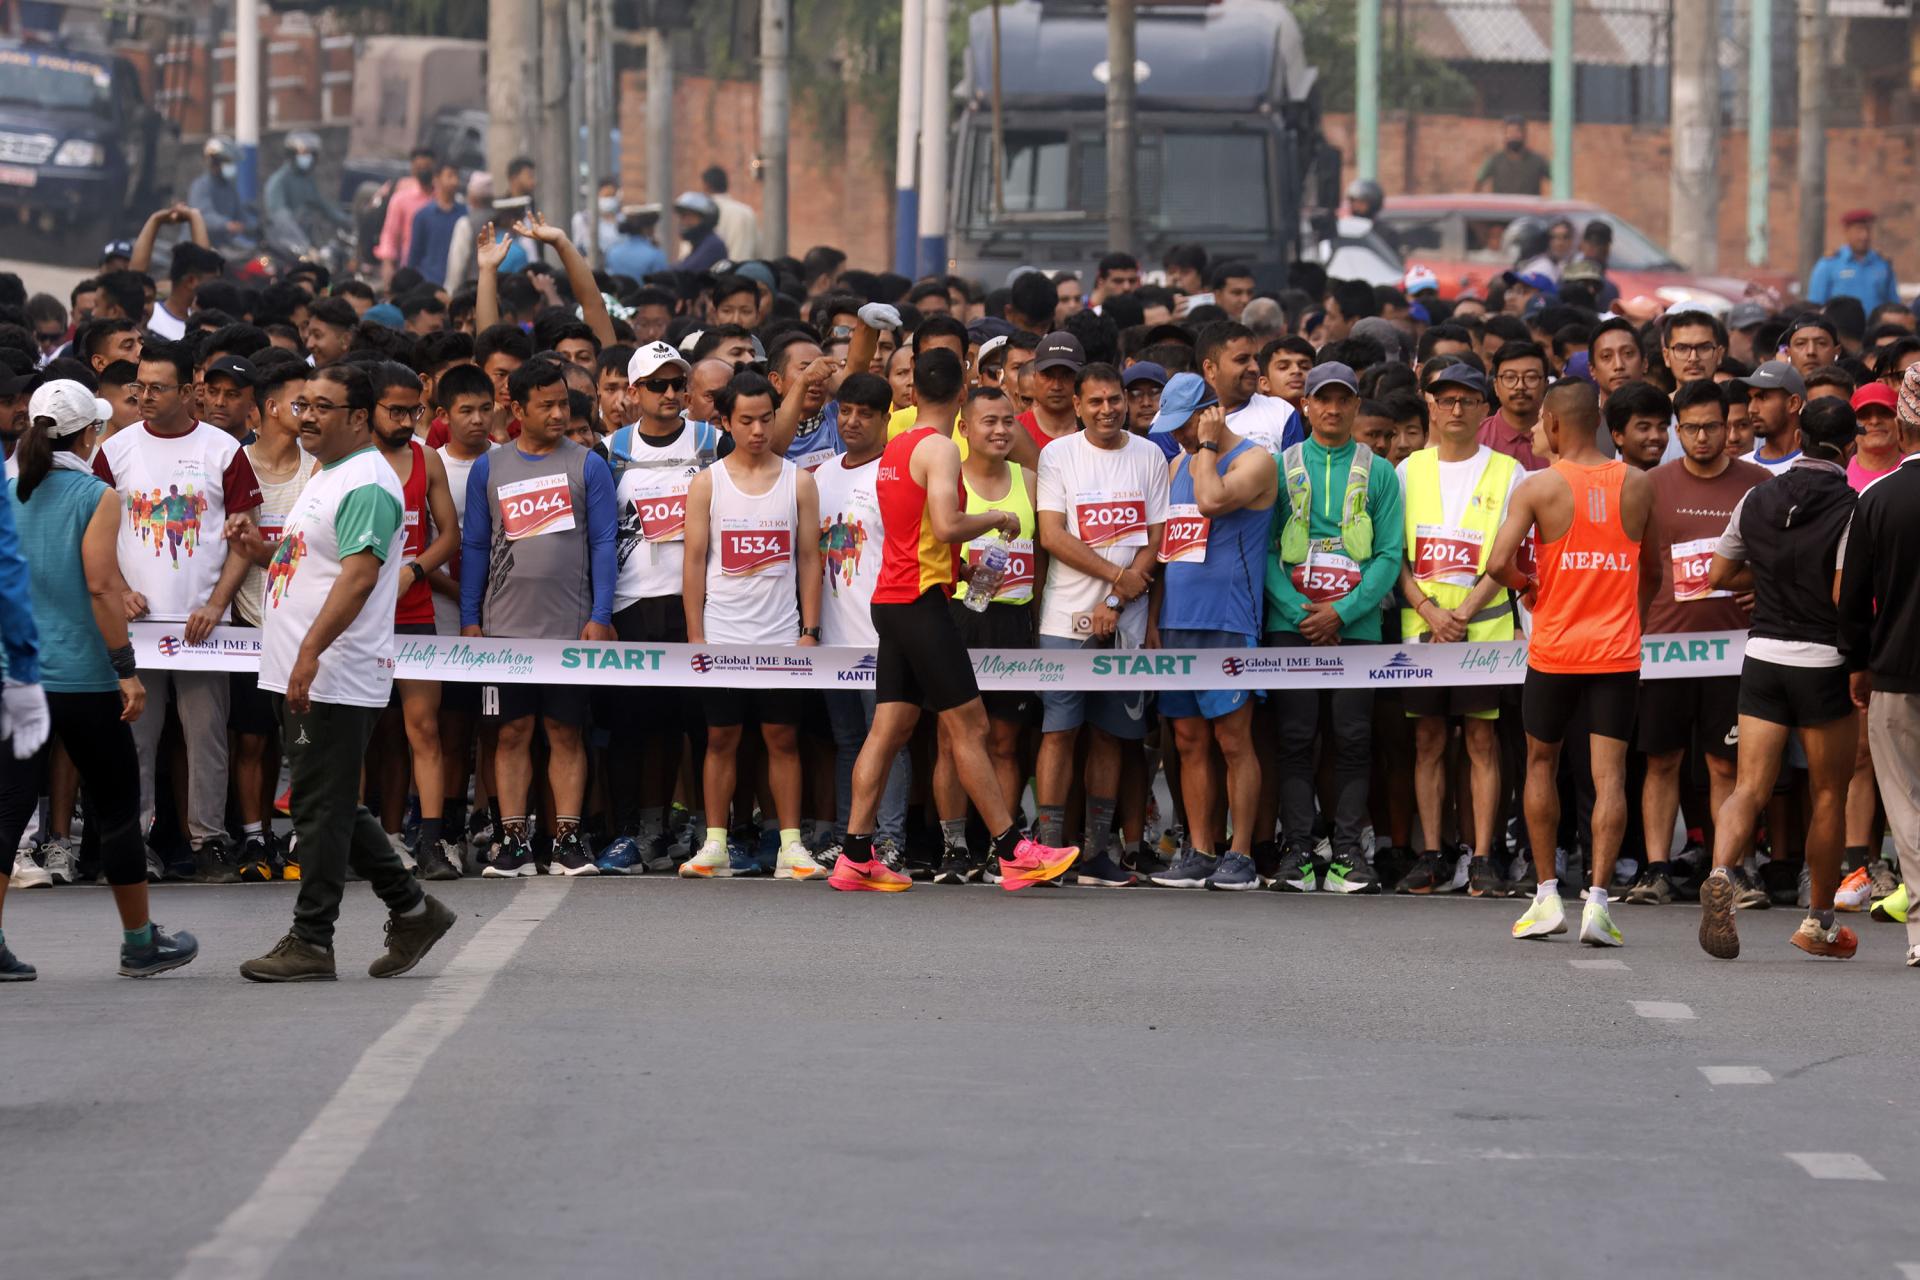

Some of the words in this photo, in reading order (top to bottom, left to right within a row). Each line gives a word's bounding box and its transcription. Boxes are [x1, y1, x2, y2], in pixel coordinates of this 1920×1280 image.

[506, 492, 565, 520] 2044
[641, 501, 686, 522] 204
[759, 520, 774, 528] 21.1
[775, 520, 789, 528] KM
[1084, 507, 1138, 527] 2029
[1168, 522, 1204, 541] 2027
[731, 536, 781, 554] 1534
[1422, 543, 1471, 565] 2014
[1561, 551, 1631, 572] NEPAL
[223, 639, 248, 650] IME
[560, 647, 666, 670] START
[714, 655, 750, 666] Global
[755, 656, 780, 666] IME
[784, 656, 813, 667] Bank
[1092, 655, 1197, 675] START
[1245, 657, 1281, 668] Global
[1287, 657, 1311, 667] IME
[1315, 656, 1344, 667] Bank
[507, 666, 533, 675] 2024
[1039, 673, 1065, 682] 2024
[1369, 668, 1433, 680] KANTIPUR
